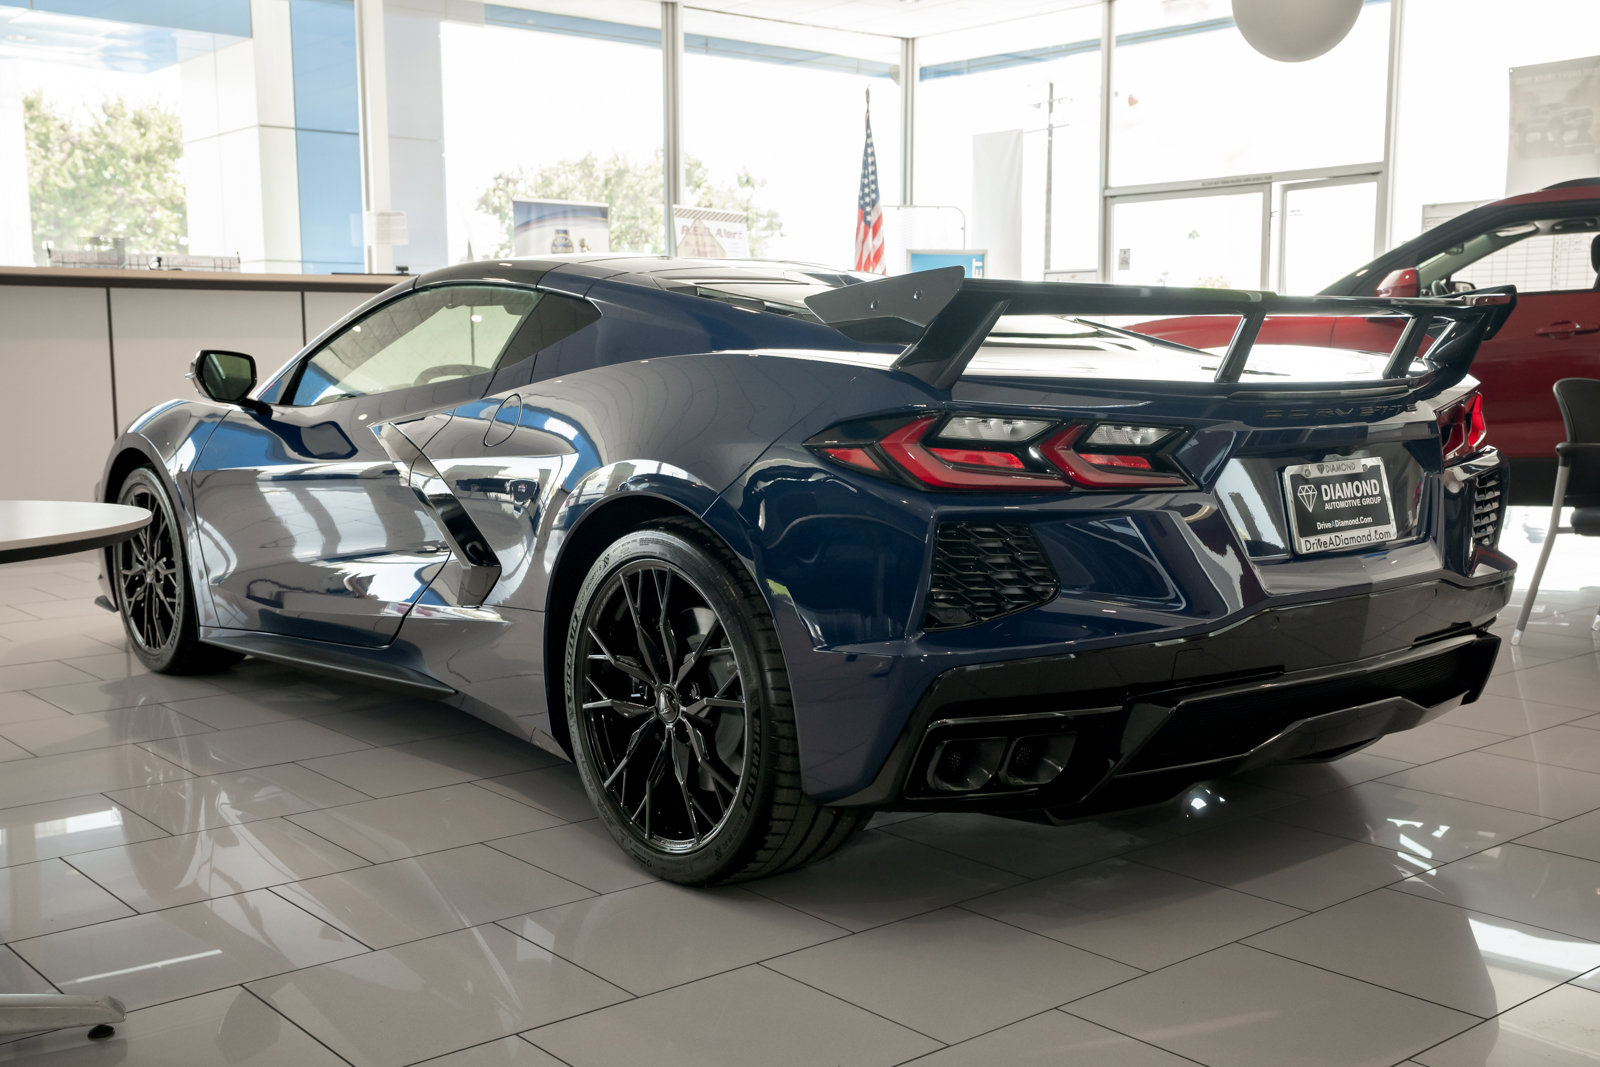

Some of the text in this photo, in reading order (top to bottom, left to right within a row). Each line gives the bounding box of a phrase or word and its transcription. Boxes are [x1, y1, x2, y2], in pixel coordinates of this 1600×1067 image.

[1264, 403, 1418, 418] CORVETTE
[1325, 462, 1356, 474] DIAMOND
[1321, 479, 1380, 501] DIAMOND
[1325, 496, 1382, 510] AUTOMOTIVE GROUP
[1316, 516, 1373, 530] DriveADiamond.Com
[744, 716, 761, 808] MICHELIN
